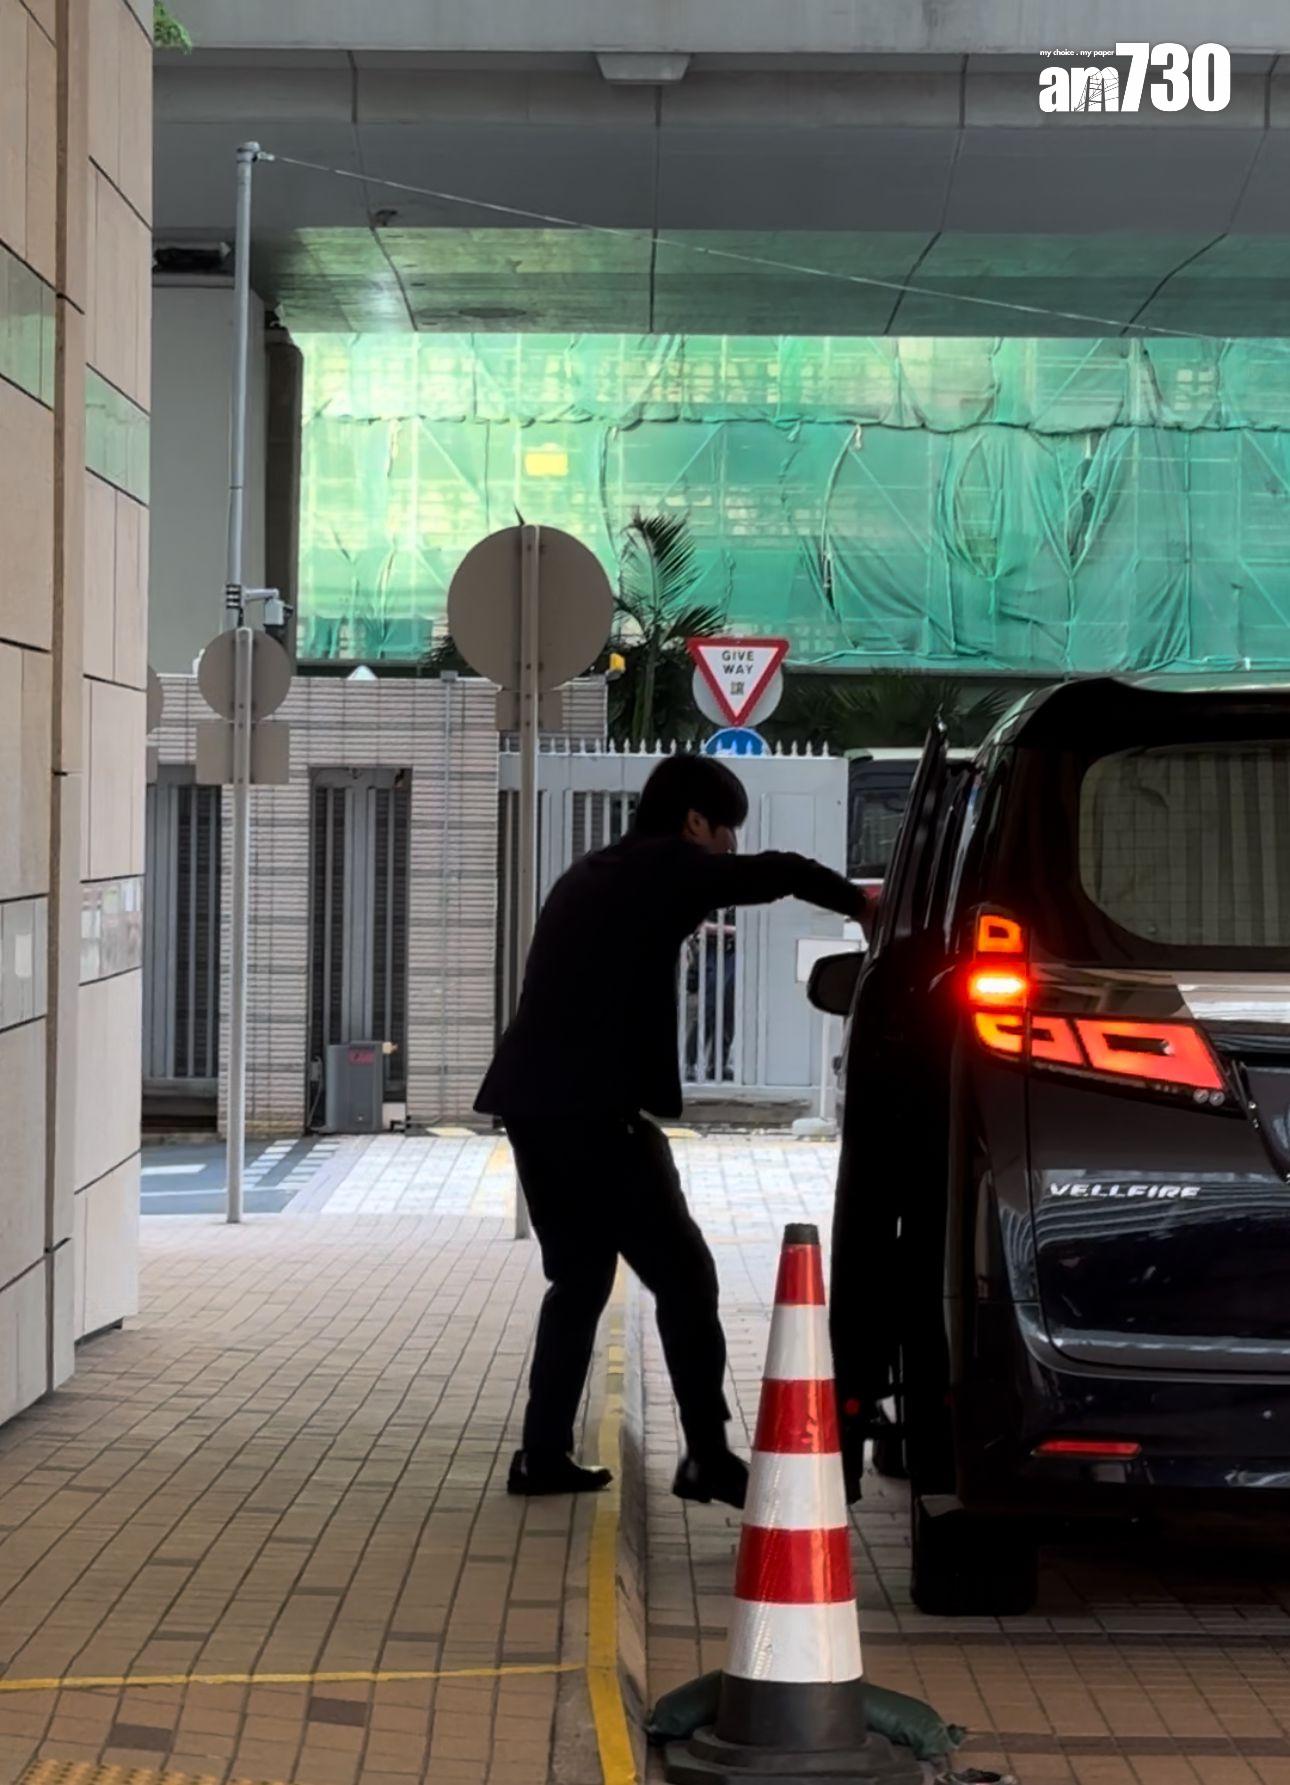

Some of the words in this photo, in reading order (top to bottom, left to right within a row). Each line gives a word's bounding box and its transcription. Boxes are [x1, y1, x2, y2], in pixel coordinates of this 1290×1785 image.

[721, 650, 754, 661] GIVE
[723, 664, 753, 675] WAY
[1050, 1183, 1201, 1198] VELLFIRE
